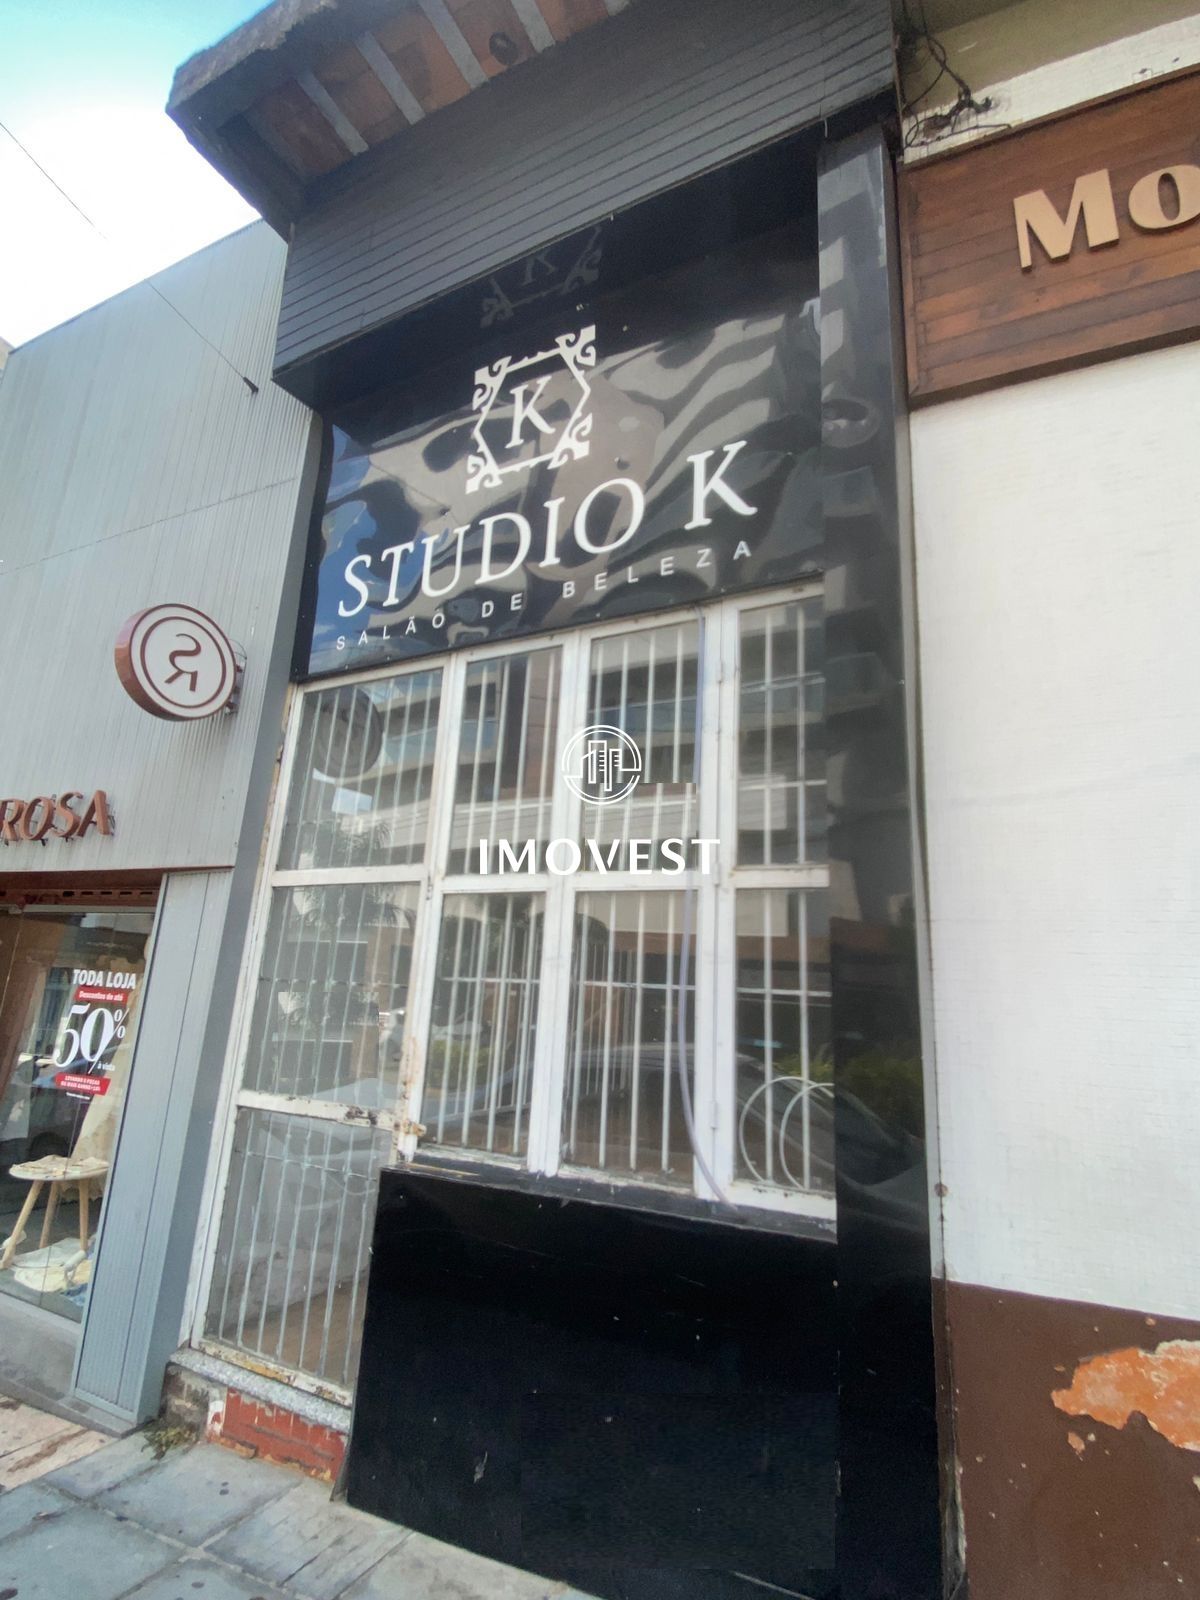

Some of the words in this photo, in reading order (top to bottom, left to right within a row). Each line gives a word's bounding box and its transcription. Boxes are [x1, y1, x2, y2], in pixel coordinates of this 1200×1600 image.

[505, 376, 556, 449] K
[338, 477, 645, 618] STUDIO
[684, 440, 758, 530] K
[336, 612, 446, 651] SALÃO
[481, 593, 523, 618] DE
[562, 540, 752, 598] BELEZA
[73, 969, 104, 987] TODA
[106, 971, 137, 989] LOJA
[55, 1003, 130, 1074] 50%
